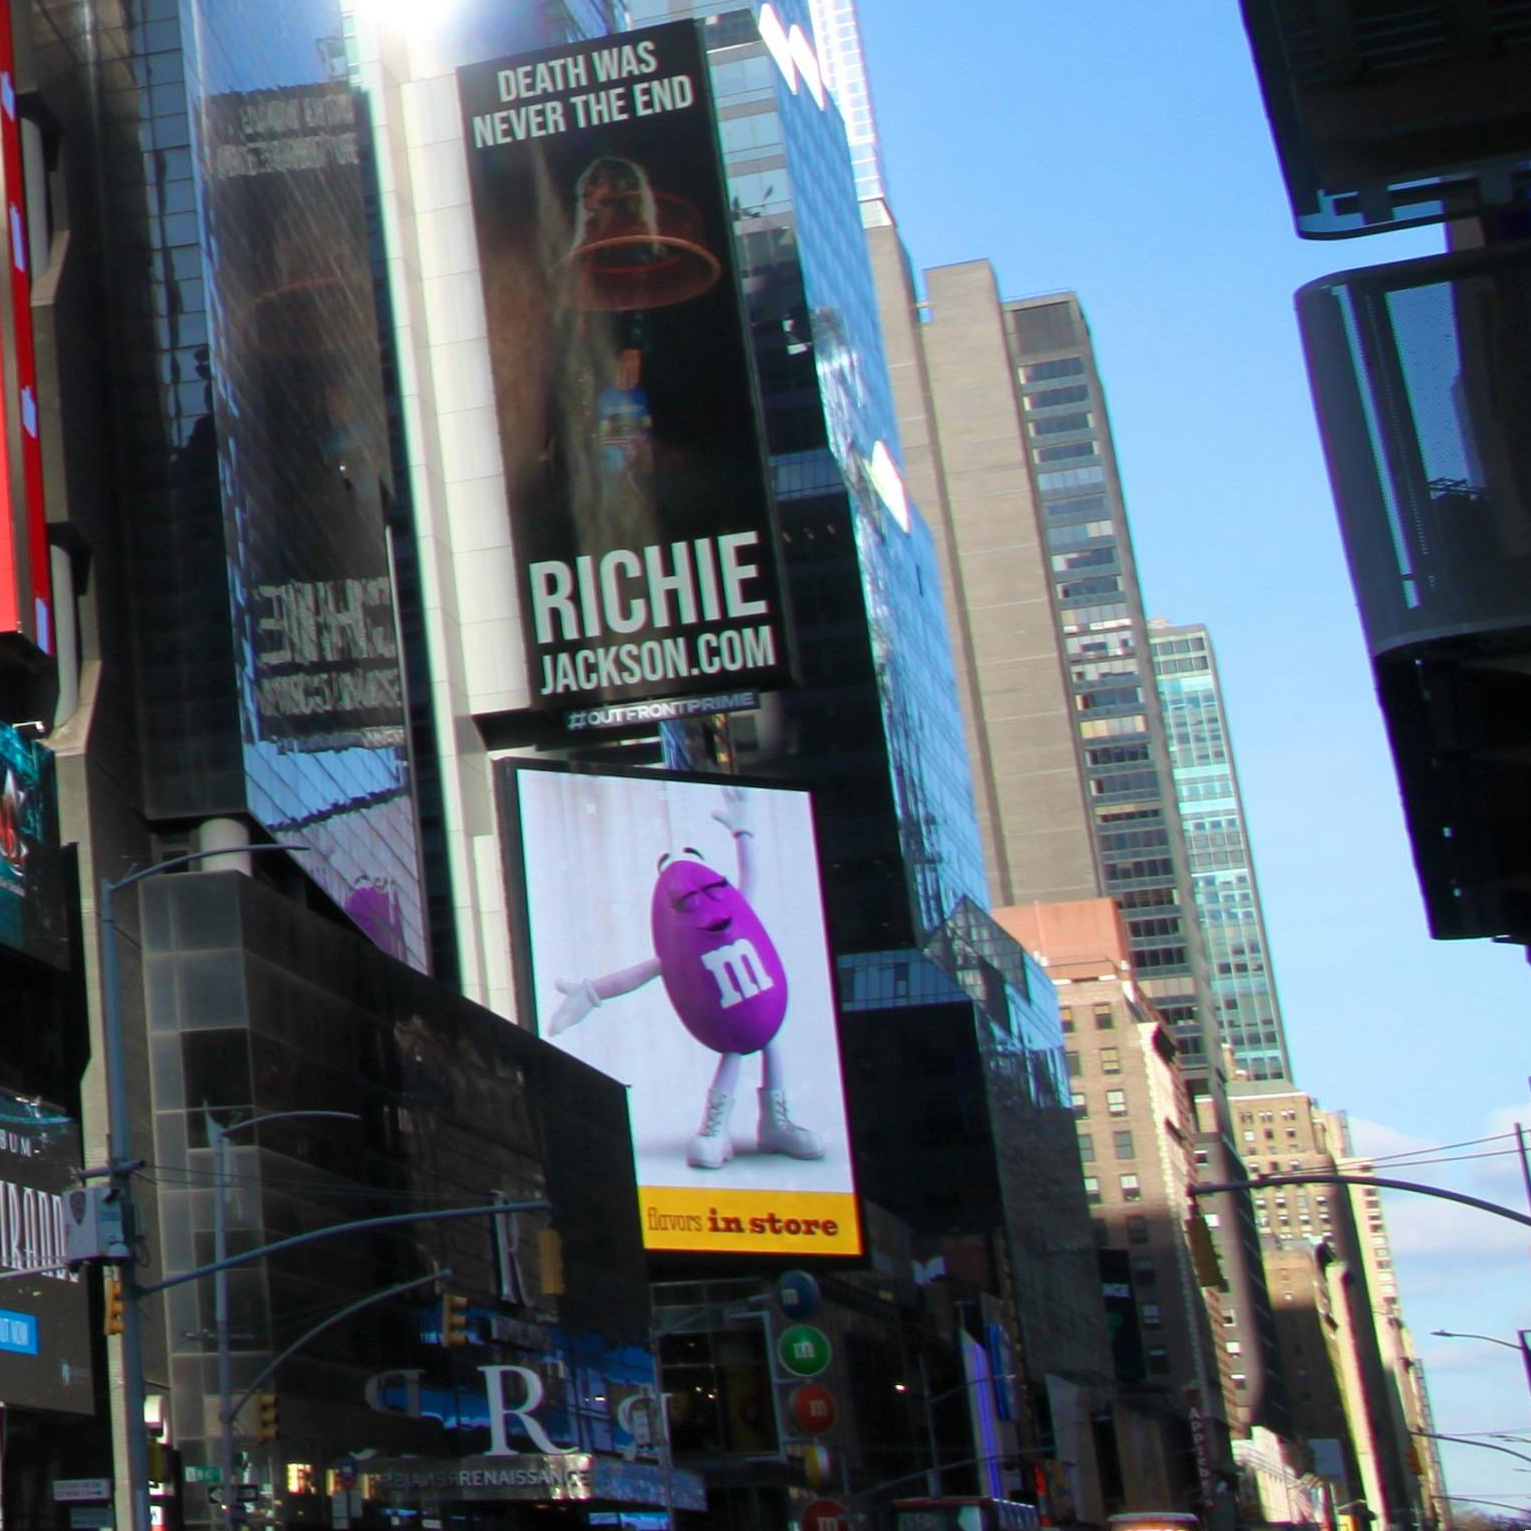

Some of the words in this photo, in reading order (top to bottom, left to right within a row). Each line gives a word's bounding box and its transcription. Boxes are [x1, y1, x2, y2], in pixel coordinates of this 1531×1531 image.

[497, 54, 588, 103] DEATH
[591, 40, 658, 83] WAS
[472, 100, 567, 149] NEVER
[570, 87, 629, 129] THE
[632, 74, 694, 117] END
[528, 530, 769, 645] RICHIE
[540, 624, 777, 696] JACKSON.COM
[566, 692, 757, 732] #OUTFRONTPRIME
[700, 937, 775, 1009] m
[647, 1207, 703, 1232] flavors
[709, 1207, 745, 1233] in
[749, 1212, 839, 1236] store
[476, 1364, 580, 1457] R
[458, 1467, 591, 1488] RENAISSANCE
